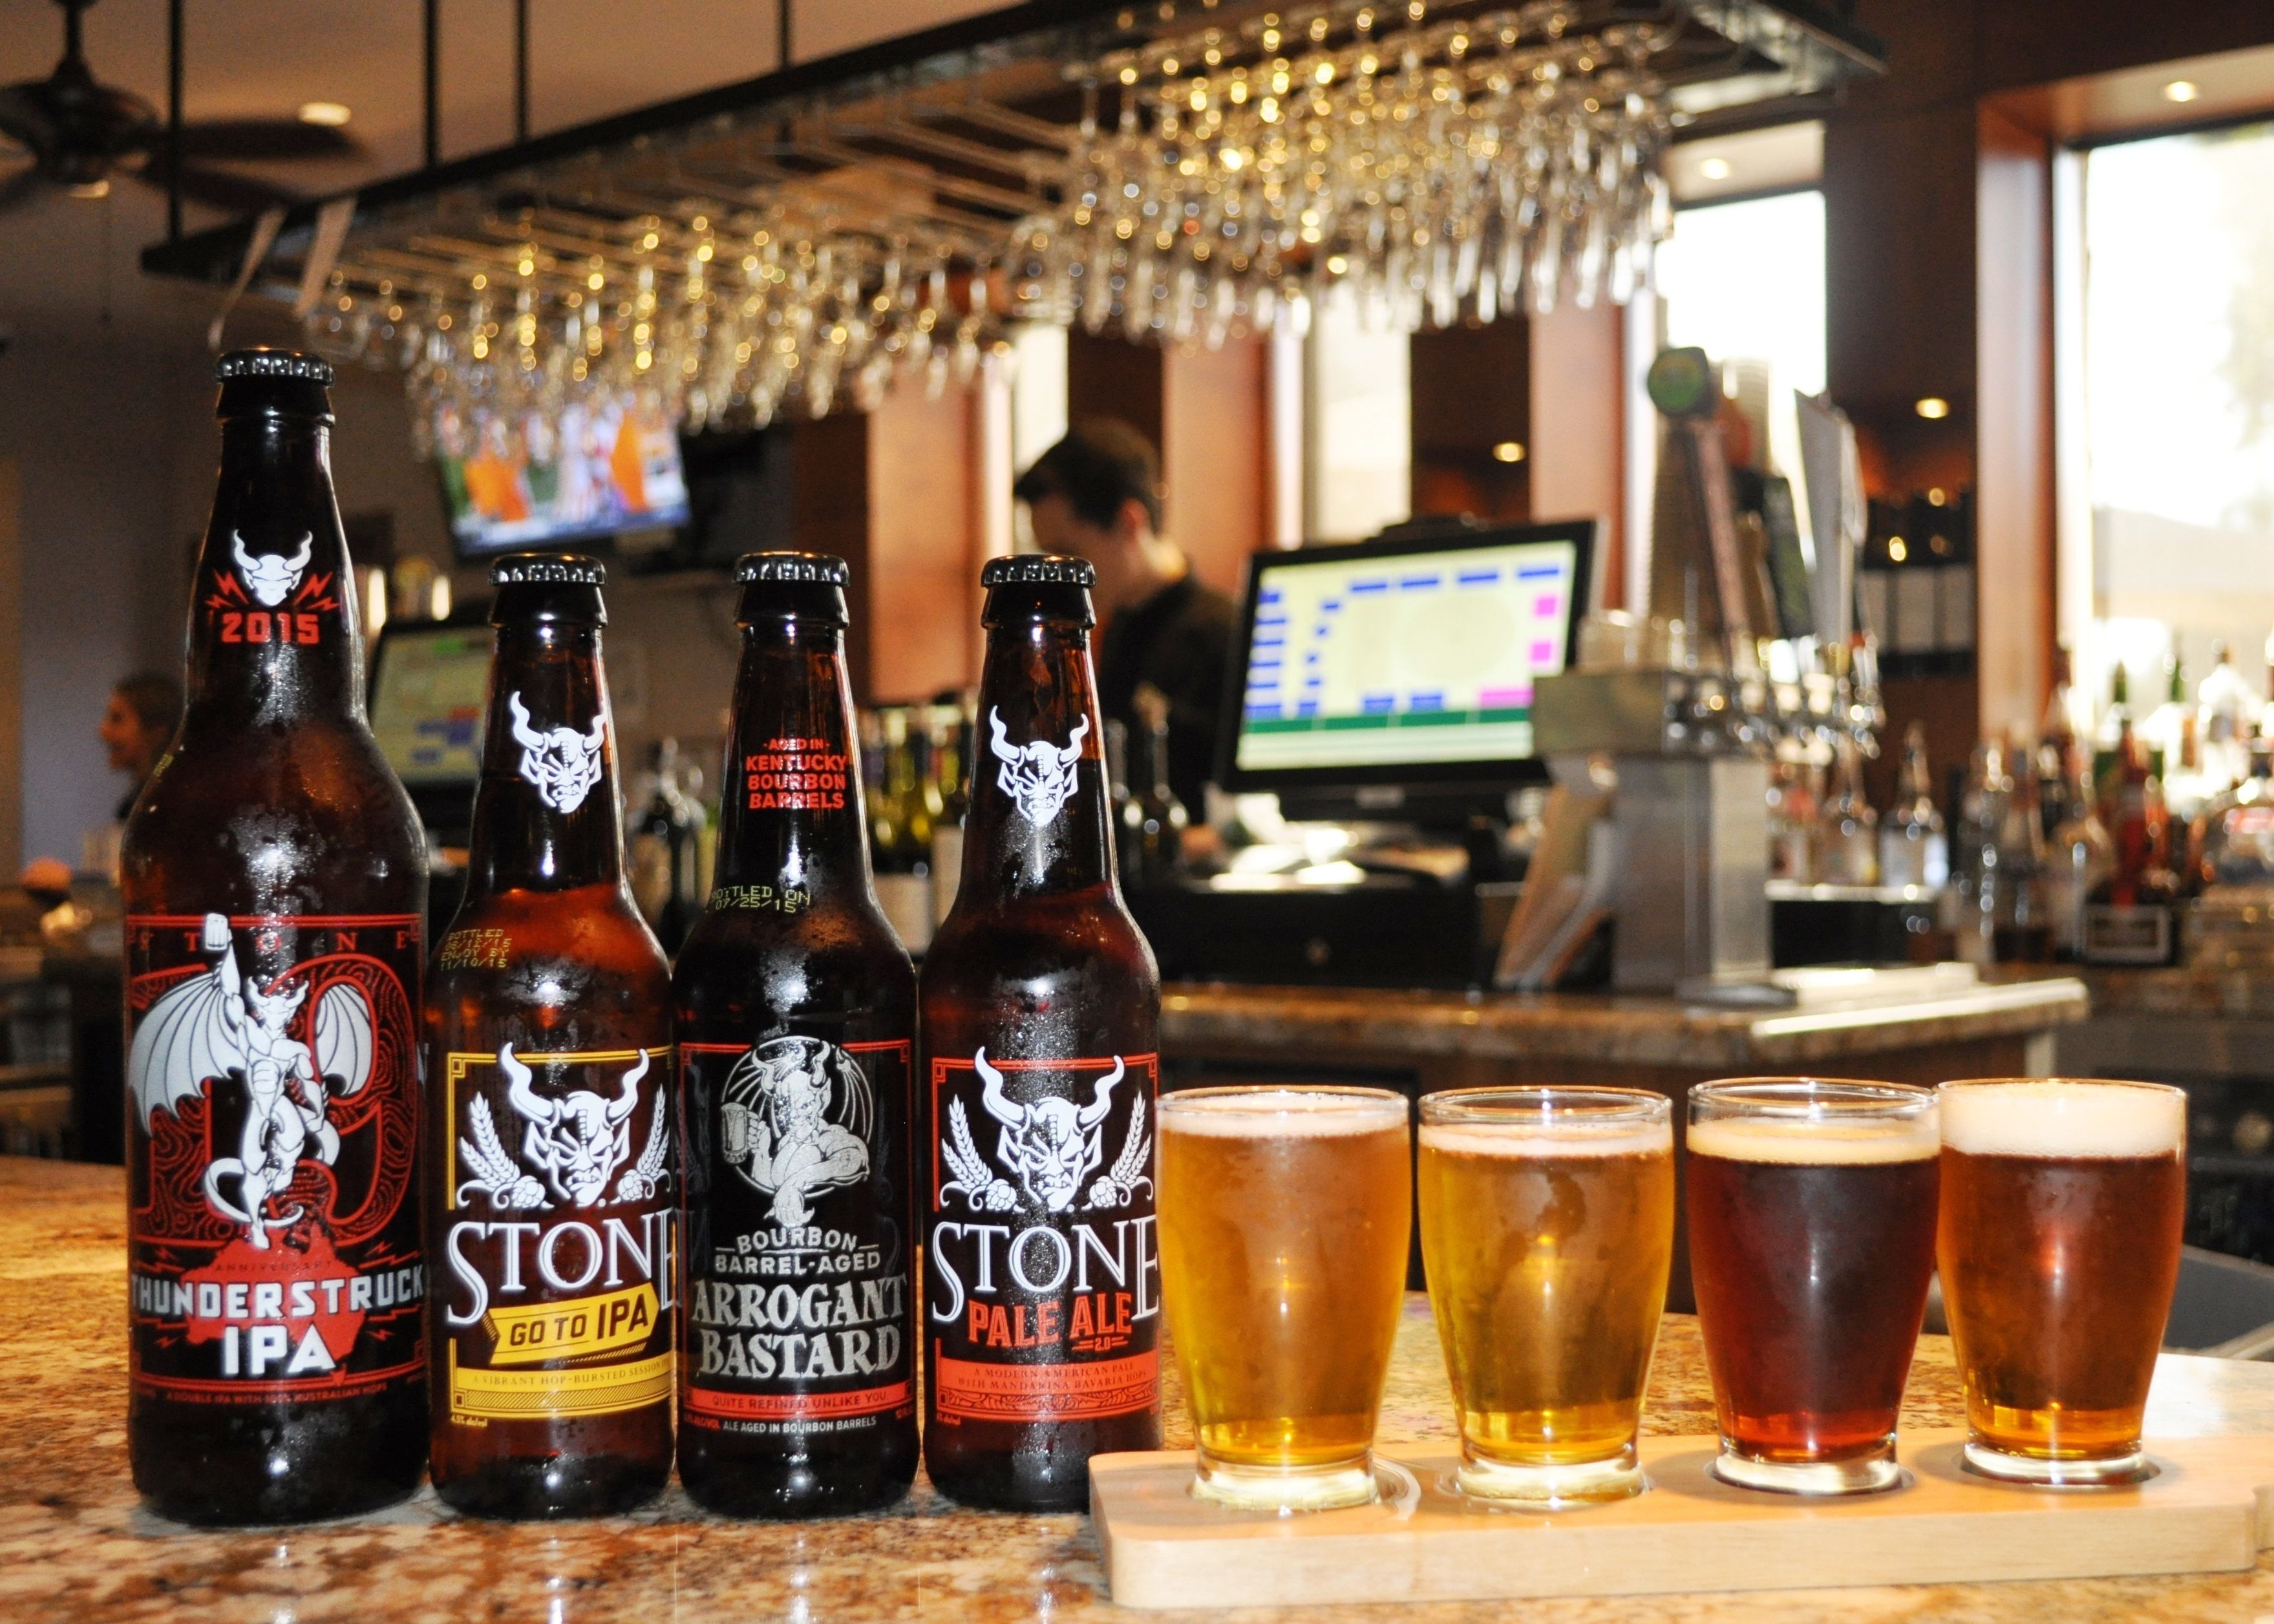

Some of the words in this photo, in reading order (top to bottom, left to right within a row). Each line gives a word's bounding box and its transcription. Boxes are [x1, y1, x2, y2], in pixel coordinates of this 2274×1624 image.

[220, 611, 320, 645] 2015
[769, 739, 807, 750] AGED
[810, 739, 824, 750] IN
[746, 755, 847, 771] KENTUCKY
[748, 774, 846, 790] BOURBON
[749, 792, 845, 808] BARRELS
[715, 897, 796, 913] 07/25/15
[785, 889, 811, 905] ON
[736, 1227, 857, 1254] BOURBON
[447, 1207, 674, 1324] STONE
[715, 1251, 880, 1275] BARREL-AGED
[932, 1214, 1159, 1322] STONE
[131, 1263, 424, 1319] THUNDERSTRUCK
[692, 1272, 907, 1329] ARROGANT
[509, 1321, 545, 1346] GO
[555, 1314, 587, 1338] TO
[597, 1292, 649, 1340] IPA
[968, 1299, 1062, 1349] PALE
[1069, 1292, 1132, 1340] ALE
[225, 1323, 336, 1375] IPA
[699, 1325, 900, 1378] BASTARD
[1094, 1336, 1111, 1351] 2.0
[541, 1370, 626, 1386] HOP-BURSTED
[712, 1395, 743, 1408] QUITE
[813, 1395, 861, 1408] UNLIKE
[866, 1391, 887, 1402] YOU
[723, 1420, 739, 1431] ALE
[741, 1423, 767, 1433] AGED
[769, 1424, 780, 1433] IN
[783, 1421, 833, 1434] BOURBON
[836, 1416, 877, 1430] BARRELS
